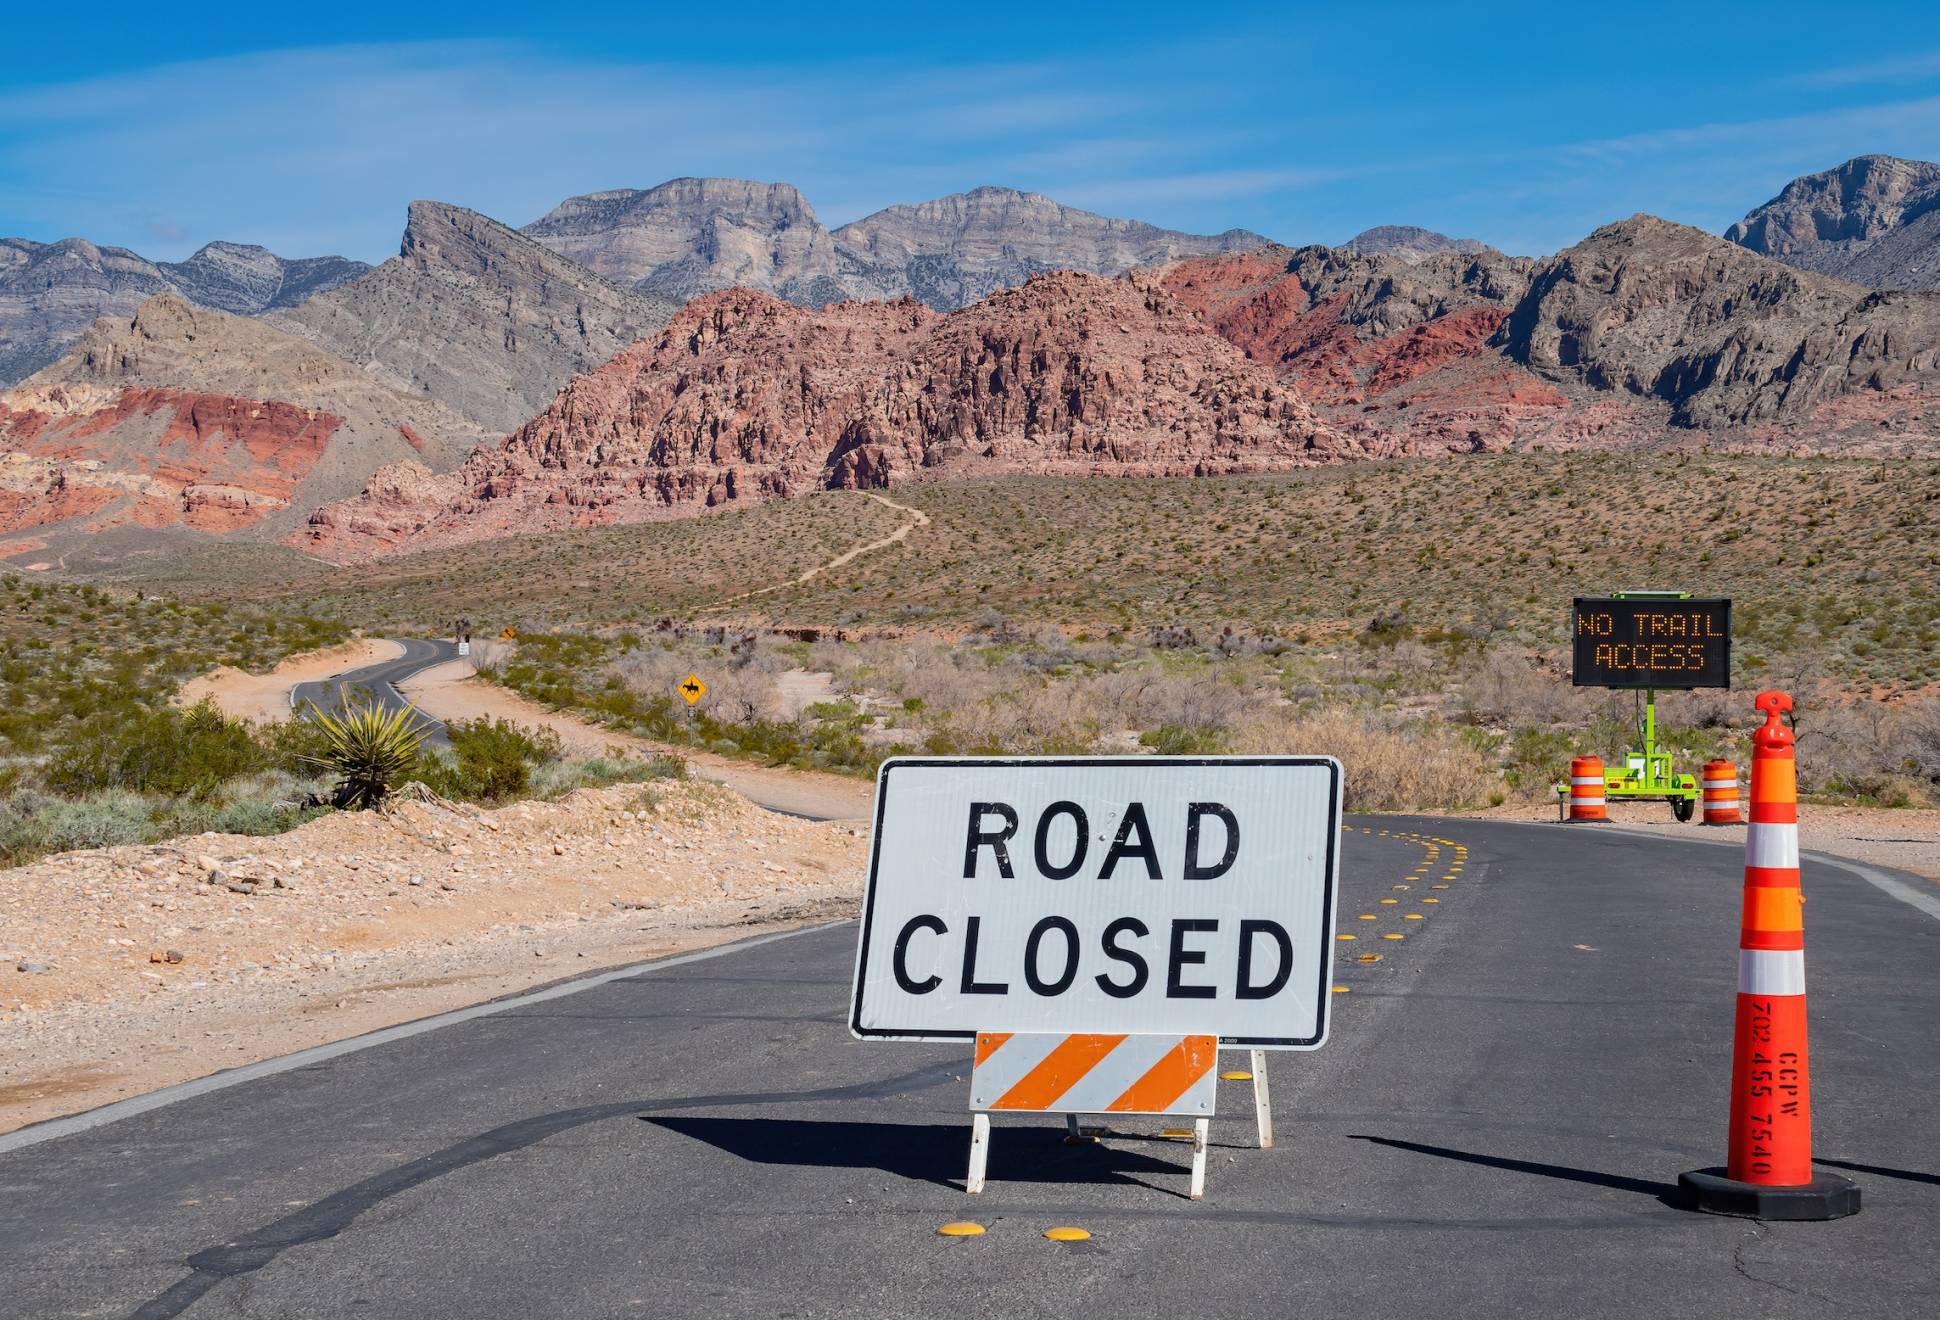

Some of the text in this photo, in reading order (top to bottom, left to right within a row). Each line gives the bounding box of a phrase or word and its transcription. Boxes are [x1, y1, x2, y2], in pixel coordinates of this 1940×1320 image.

[1578, 613, 1723, 637] NO TRAIL
[1595, 643, 1704, 670] ACCESS
[963, 800, 1240, 881] ROAD
[892, 914, 1294, 1000] CLOSED
[1751, 1002, 1772, 1175] 702 455 7540
[1779, 1052, 1798, 1117] CCPW
